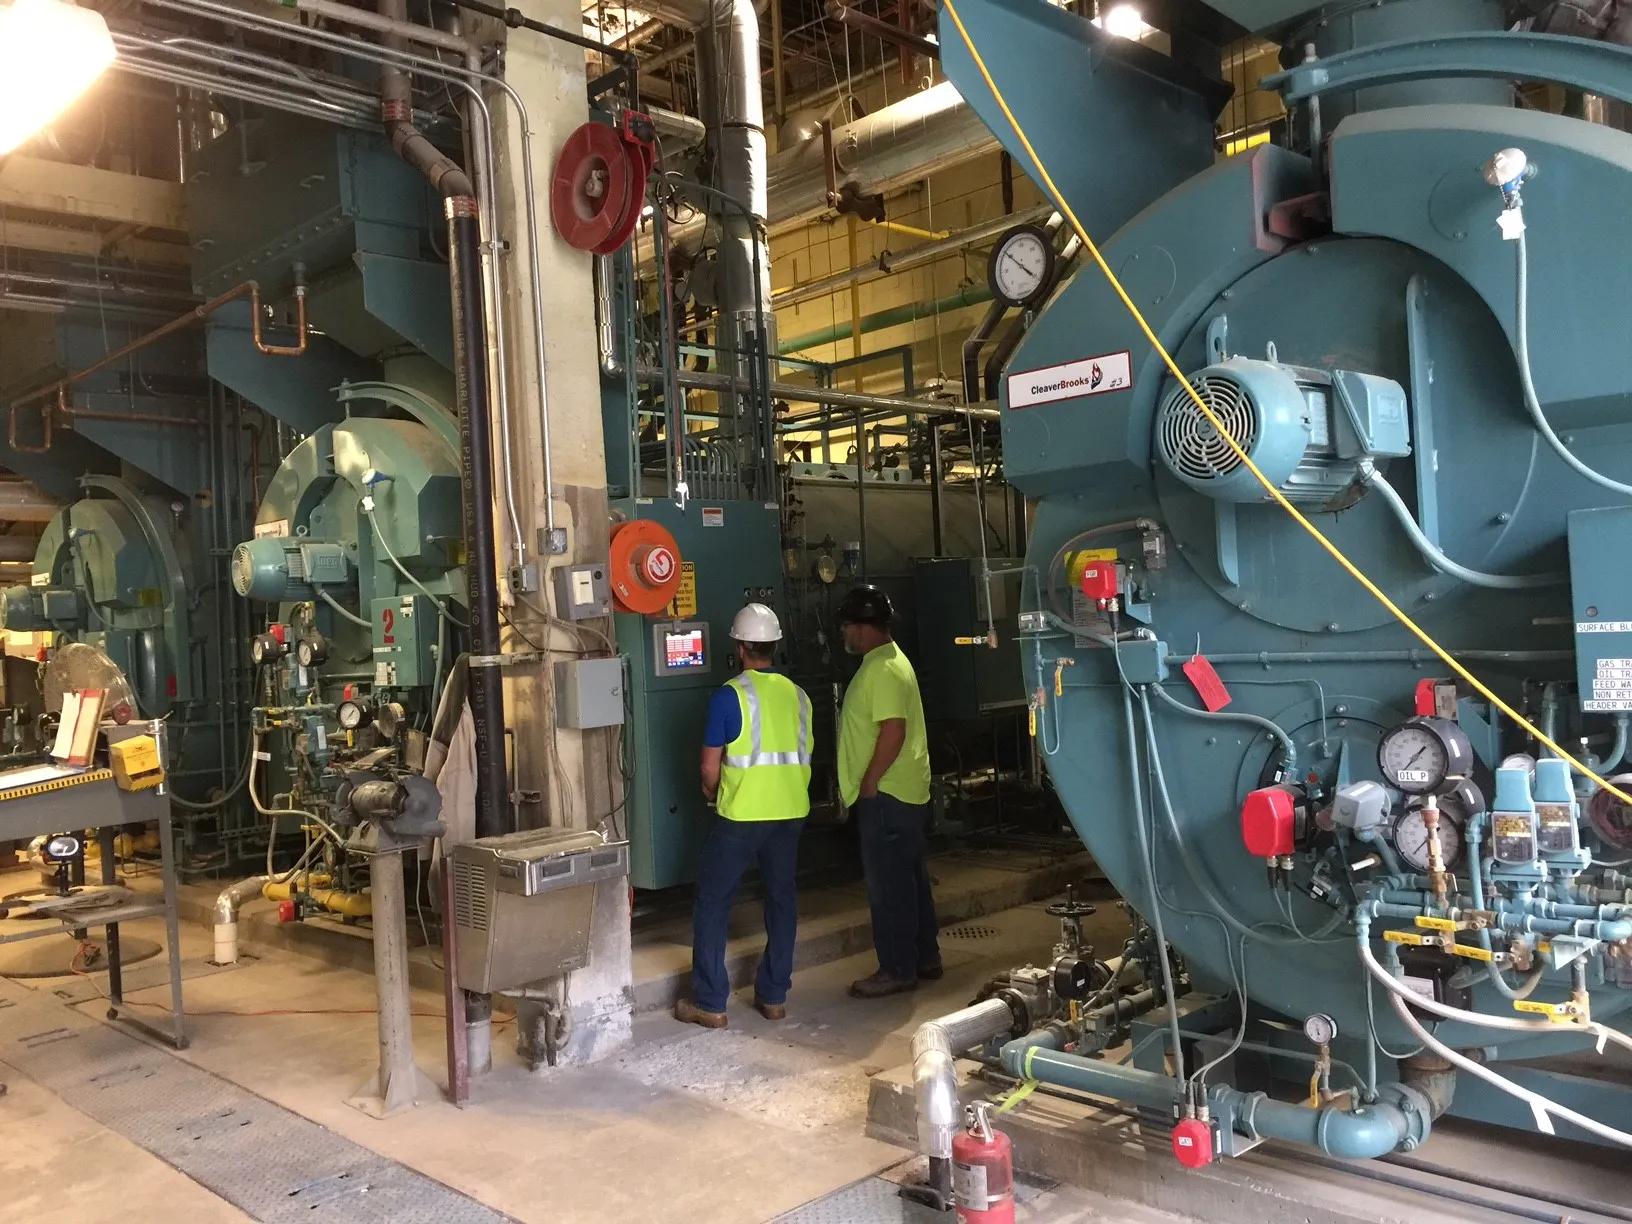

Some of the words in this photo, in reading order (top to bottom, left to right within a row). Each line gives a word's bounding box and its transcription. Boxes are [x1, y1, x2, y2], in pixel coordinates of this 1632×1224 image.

[1031, 376, 1089, 394] CleaverBrooks
[458, 366, 470, 438] CHARLOTTE
[465, 502, 474, 526] USA
[469, 574, 479, 598] HUB
[382, 608, 395, 644] 2
[1578, 624, 1615, 632] SURFACE
[1620, 622, 1632, 631] BL
[1598, 660, 1615, 668] GAS
[1620, 660, 1632, 668] TR
[1598, 670, 1614, 678] OIL
[1620, 670, 1632, 678] TR
[1594, 680, 1616, 689] FEED
[1595, 691, 1611, 699] NON
[1586, 702, 1617, 710] HEADER
[1400, 772, 1416, 780] OIL
[1421, 772, 1426, 780] P
